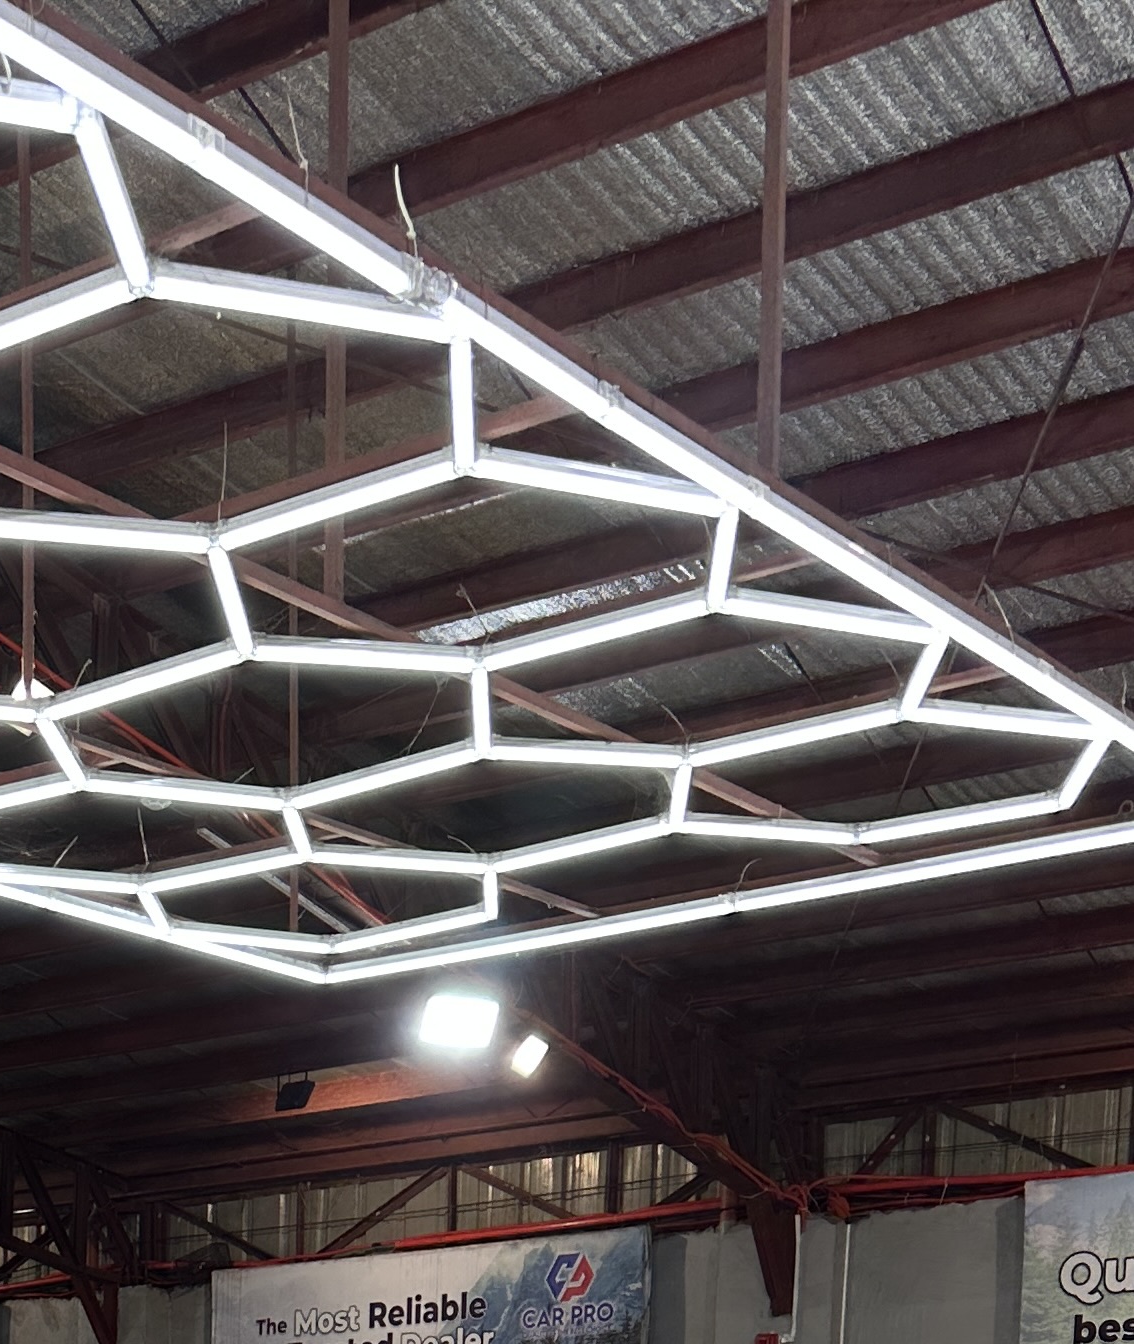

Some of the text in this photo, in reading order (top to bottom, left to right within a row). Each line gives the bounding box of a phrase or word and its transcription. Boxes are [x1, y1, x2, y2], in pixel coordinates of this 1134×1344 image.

[256, 1291, 487, 1337] The Most Reliable
[522, 1302, 614, 1328] CAR PRO
